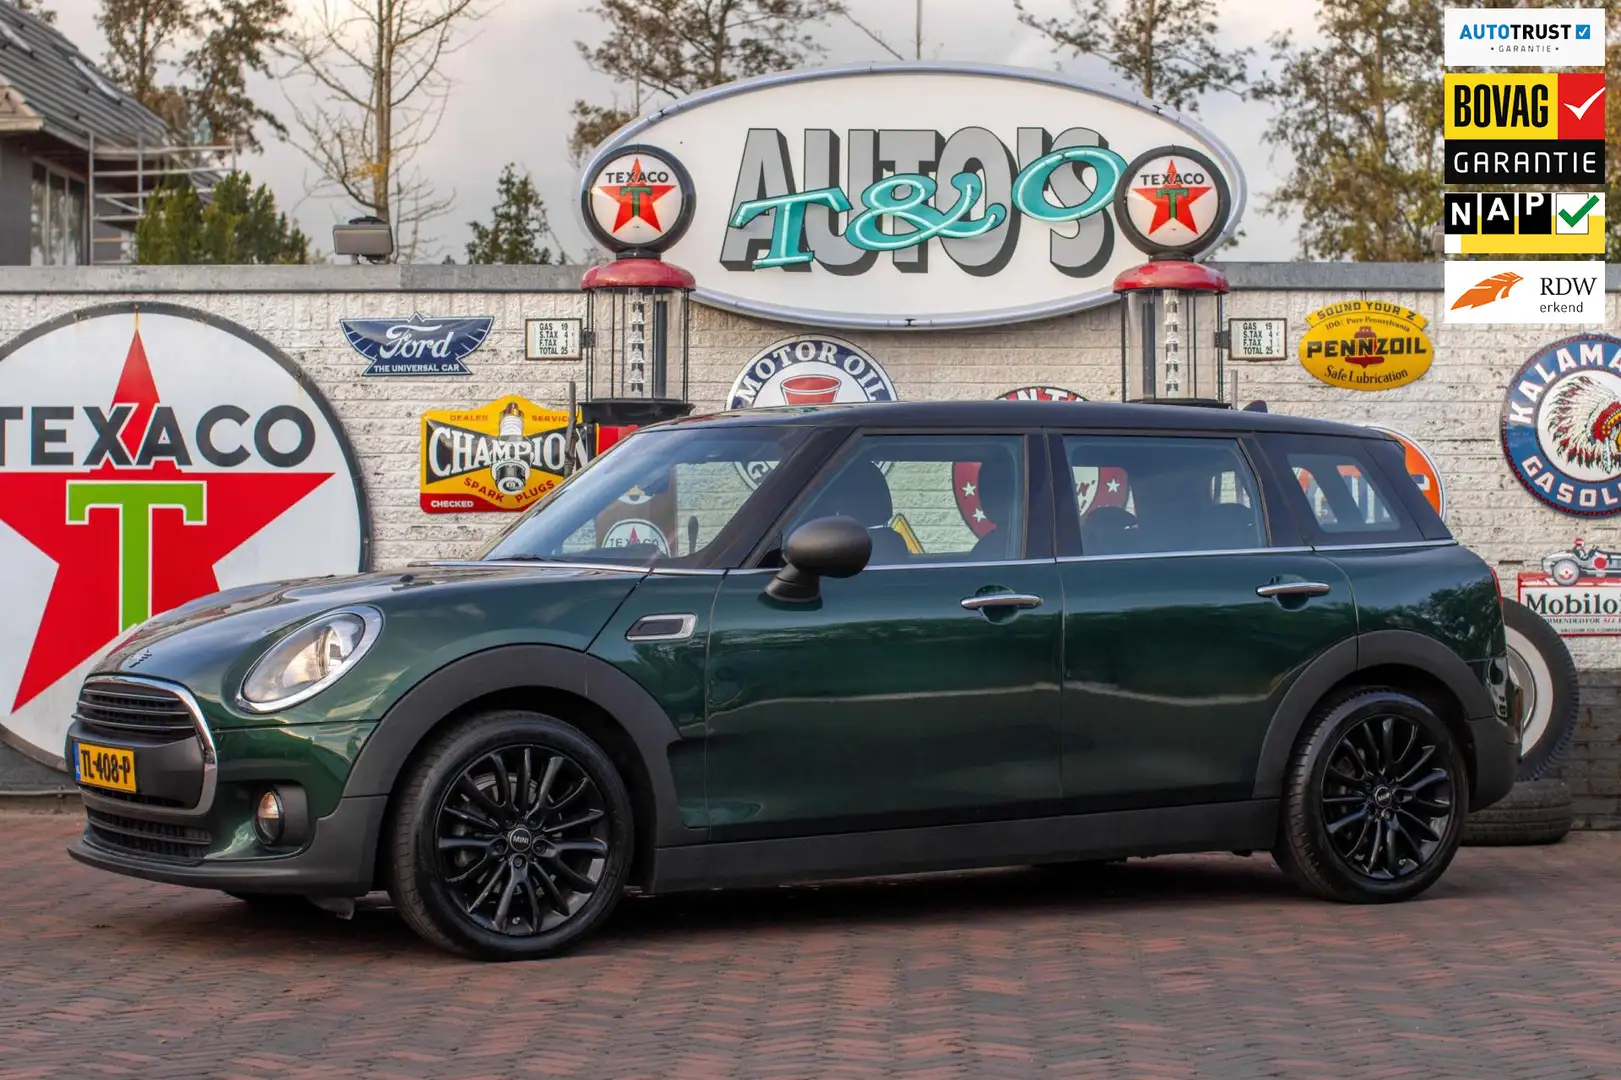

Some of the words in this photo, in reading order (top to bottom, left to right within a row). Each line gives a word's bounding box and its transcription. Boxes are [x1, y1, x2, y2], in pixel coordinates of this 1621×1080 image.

[605, 171, 669, 184] TEXACO
[1140, 172, 1205, 186] TEXACO
[1317, 301, 1361, 320] SOUND
[1366, 301, 1401, 315] YOUR
[539, 322, 554, 331] GAS
[1242, 322, 1257, 331] GAS
[380, 324, 455, 359] Ford
[539, 331, 559, 339] S.TAX
[1242, 331, 1263, 339] S.TAX
[539, 347, 559, 355] TOTAL
[560, 346, 569, 355] 25
[1243, 347, 1264, 355] TOTAL
[1307, 337, 1428, 359] PENNZOIL
[374, 365, 391, 373] THE
[391, 364, 438, 373] UNIVERSAL
[441, 364, 460, 372] CAR
[735, 341, 839, 405] MOTOR
[843, 354, 886, 402] OIL
[1324, 364, 1349, 381] Safe
[1348, 367, 1409, 384] Lubrication
[450, 414, 489, 422] DEALER
[532, 414, 570, 422] SERVIC
[1522, 455, 1621, 508] GASOL
[463, 477, 505, 503] SPARK
[515, 480, 556, 503] PLUGS
[430, 500, 475, 508] CHECKED
[1526, 593, 1621, 615] Mobilo
[80, 749, 132, 785] TL-408-P
[512, 835, 529, 845] MINI
